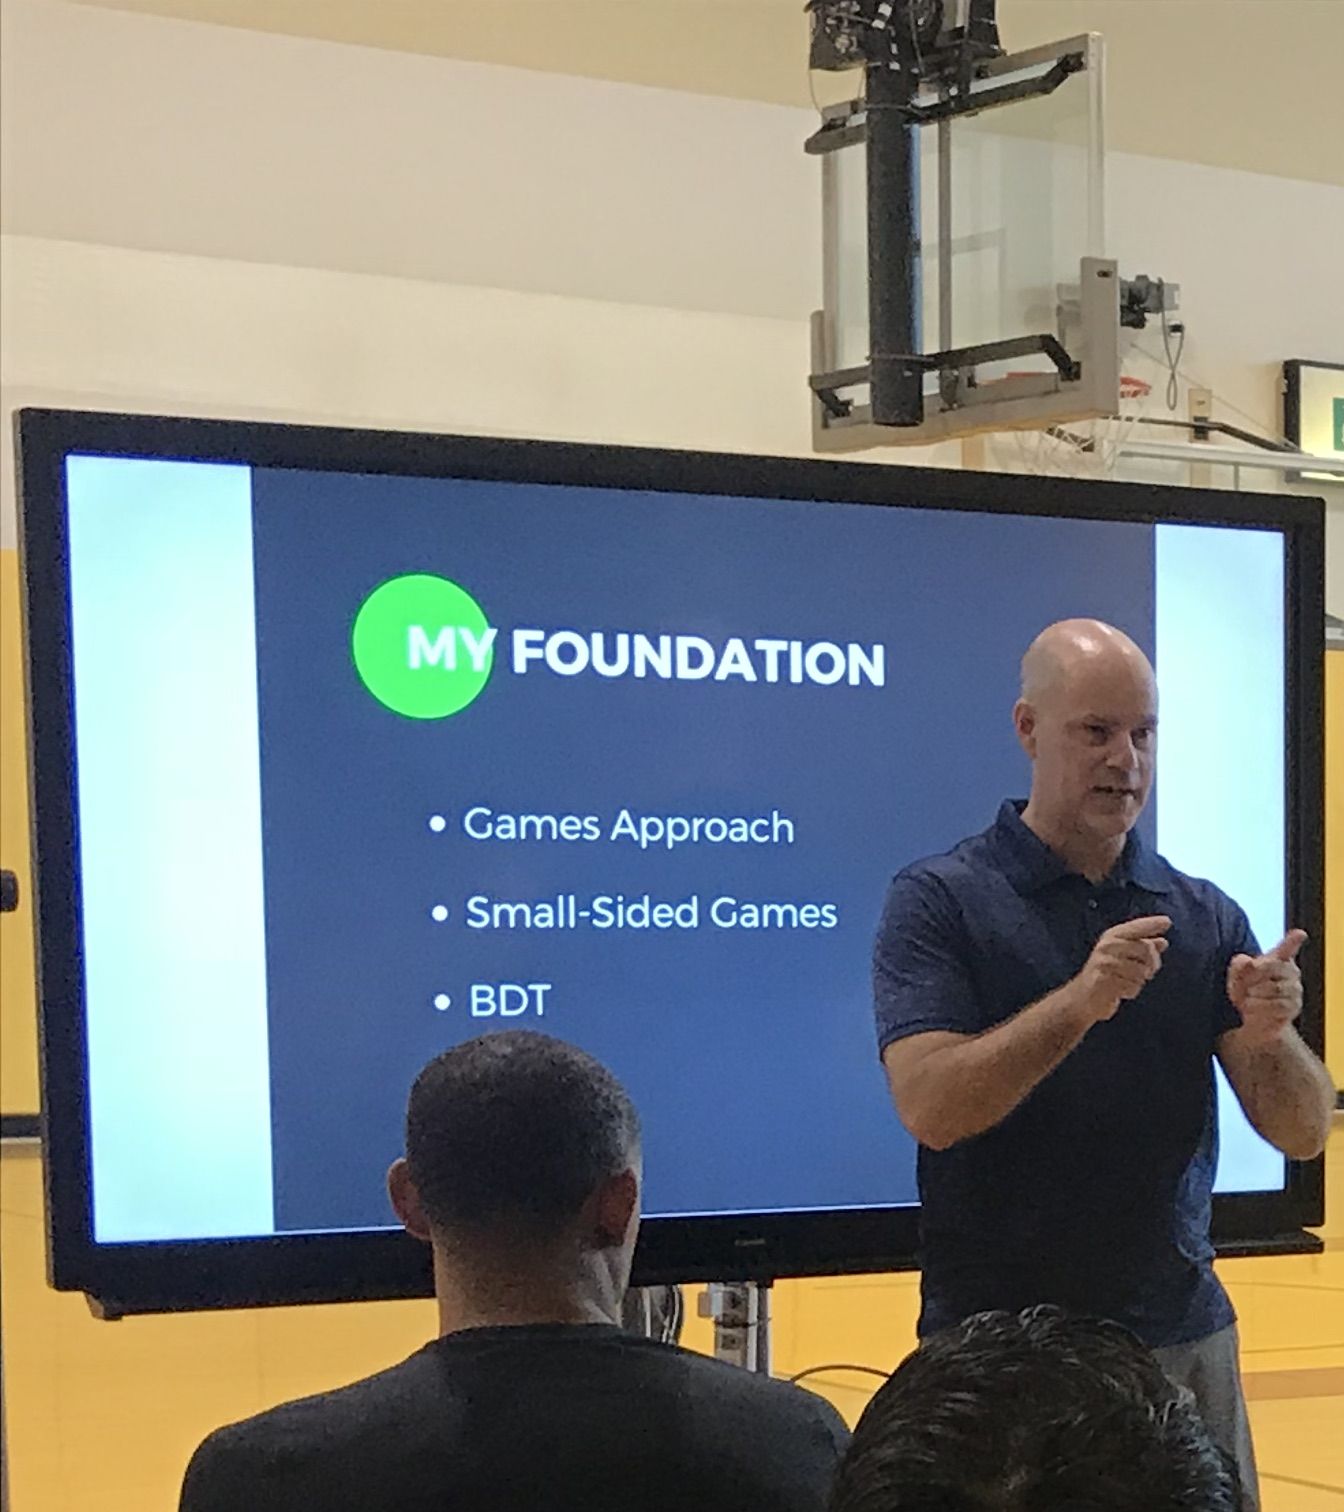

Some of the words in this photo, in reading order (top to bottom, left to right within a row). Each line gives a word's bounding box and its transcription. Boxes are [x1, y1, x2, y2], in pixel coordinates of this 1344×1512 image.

[407, 625, 497, 671] MY
[512, 629, 886, 687] FOUNDATION
[464, 807, 600, 841] Games
[610, 809, 795, 849] Approach
[465, 895, 698, 929] Small-Sided
[710, 897, 838, 929] Games
[471, 984, 552, 1017] BDT
